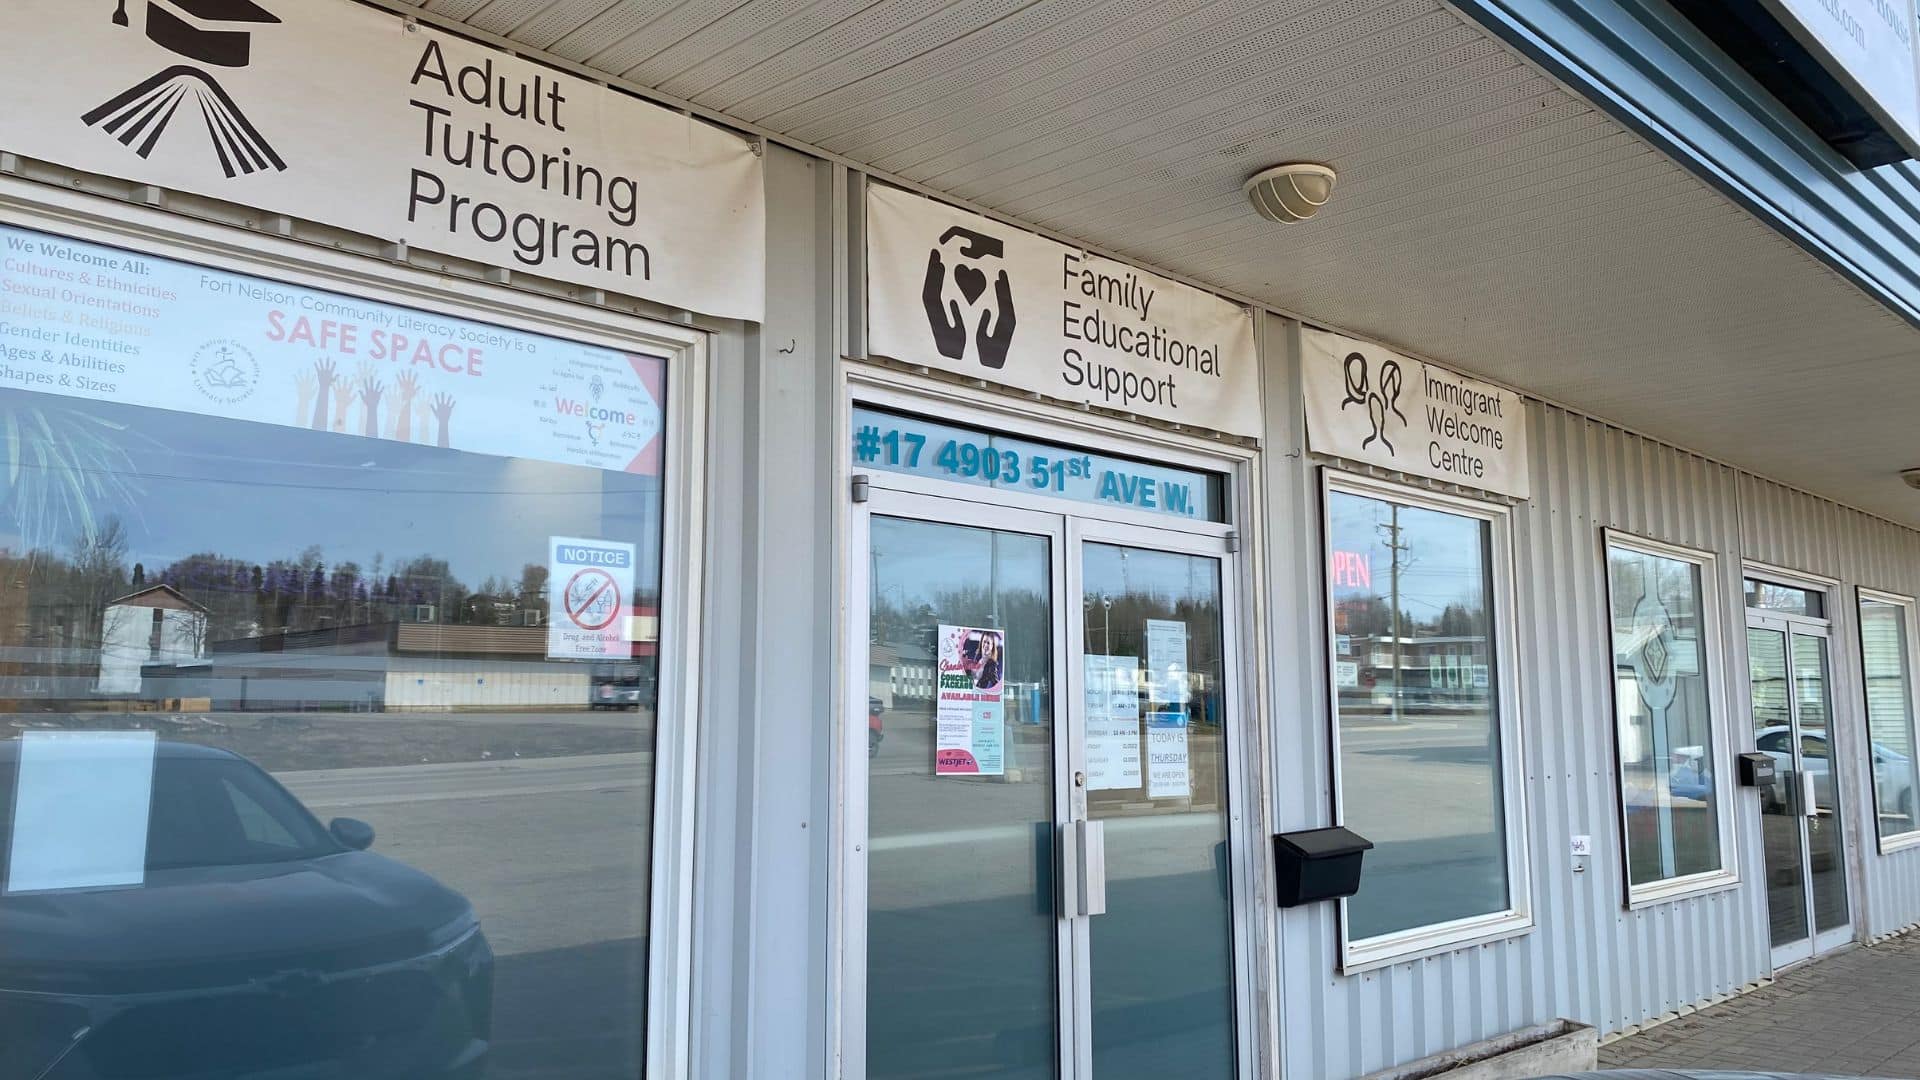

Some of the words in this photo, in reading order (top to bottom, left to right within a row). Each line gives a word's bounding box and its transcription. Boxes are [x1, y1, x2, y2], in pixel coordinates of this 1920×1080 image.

[410, 39, 566, 132] Adult
[409, 99, 638, 227] Tutoring
[408, 167, 650, 281] Program
[7, 236, 34, 253] We
[40, 242, 118, 269] Welcome
[121, 259, 151, 276] All:
[2, 278, 56, 300] Sexual
[62, 288, 161, 319] Orientations
[4, 257, 74, 282] Cultures
[79, 271, 91, 285] &
[96, 274, 177, 301] Ethnicities
[1063, 253, 1154, 321] Family
[63, 310, 73, 324] &
[200, 275, 232, 295] Fort
[238, 283, 295, 305] Nelson
[301, 295, 393, 328] Community
[397, 315, 456, 339] Literacy
[459, 327, 512, 349] Society
[514, 337, 523, 351] is
[527, 343, 536, 354] a
[0, 321, 60, 342] Gender
[65, 332, 141, 356] Identities
[0, 343, 37, 361] Ages
[41, 349, 55, 363] &
[58, 352, 126, 374] Abilities
[266, 309, 358, 354] SAFE
[369, 329, 483, 376] SPACE
[1063, 300, 1220, 378] Educational
[58, 373, 72, 388] &
[76, 375, 117, 393] Sizes
[1063, 349, 1177, 409] Support
[1424, 368, 1503, 418] Immigrant
[555, 396, 635, 425] Welcome
[1425, 404, 1503, 450] Welcome
[856, 425, 927, 468] #17
[937, 439, 1021, 484] 4903
[1031, 455, 1091, 492] 51st
[1100, 470, 1156, 508] AVE
[1164, 481, 1194, 515] W.
[1428, 440, 1484, 478] Centre
[564, 548, 625, 565] NOTICE
[1332, 551, 1370, 588] PEN
[1152, 733, 1175, 743] TODAY
[1152, 752, 1187, 762] THURSDAY
